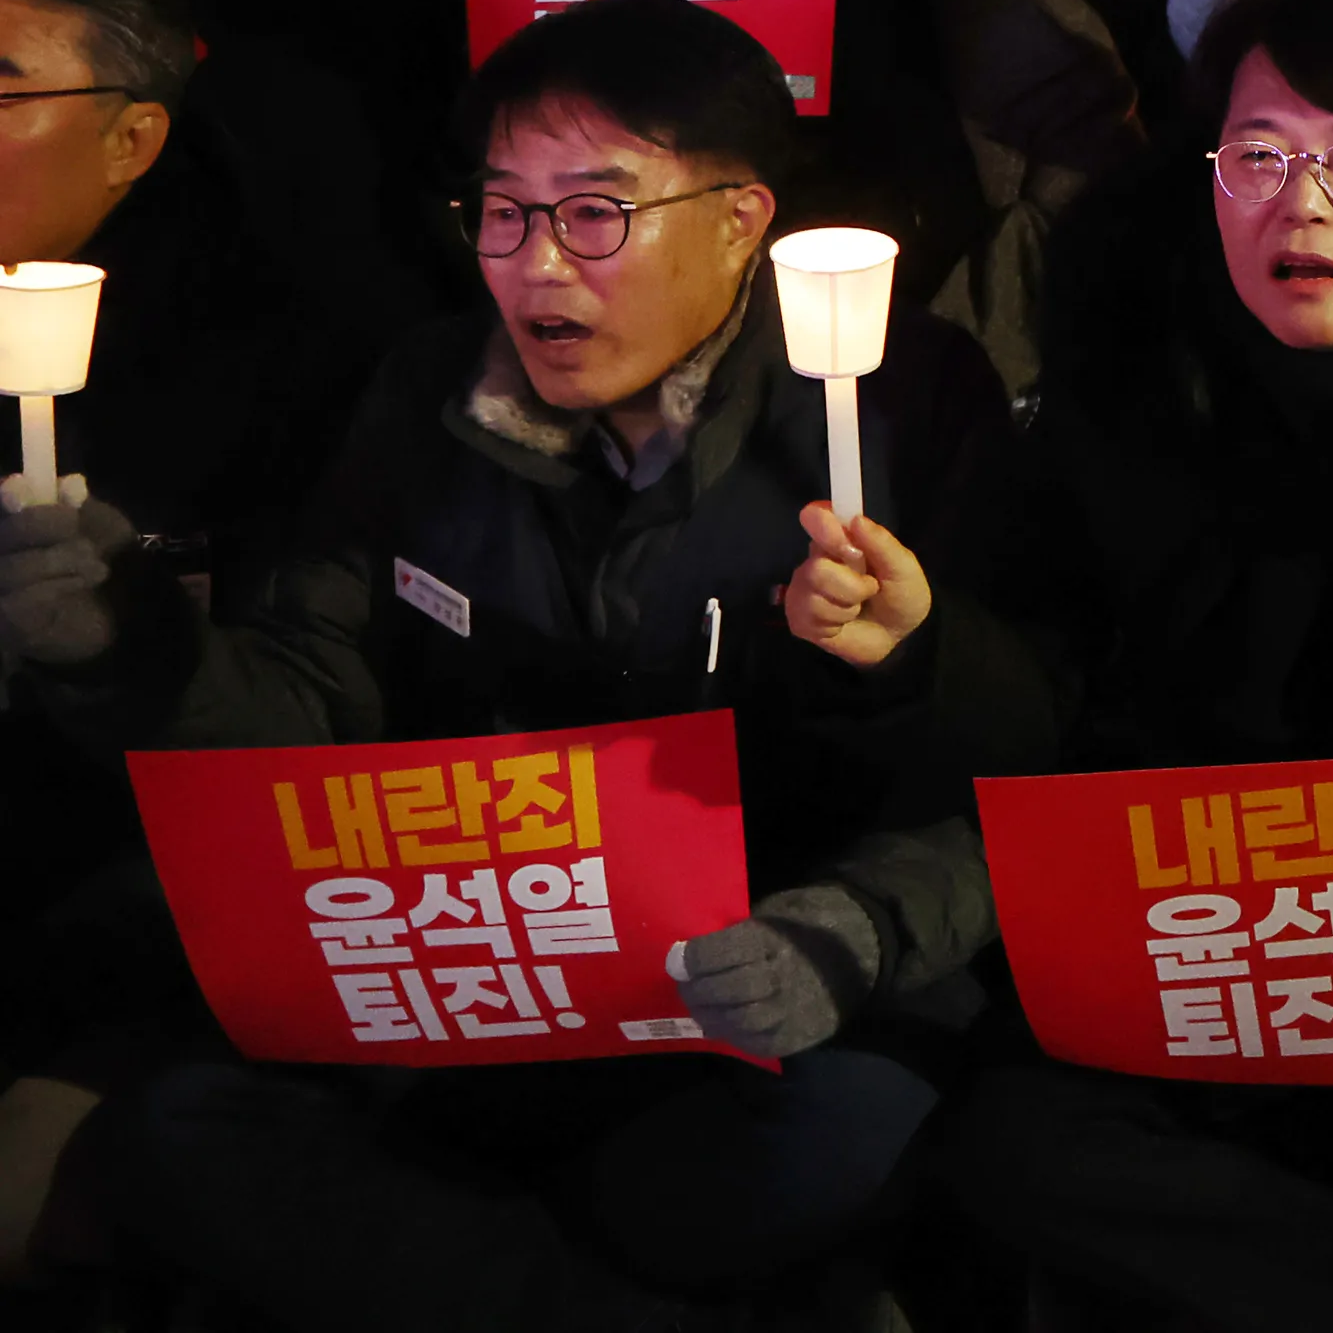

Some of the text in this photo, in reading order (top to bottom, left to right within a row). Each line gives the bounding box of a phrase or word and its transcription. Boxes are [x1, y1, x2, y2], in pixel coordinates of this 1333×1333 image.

[272, 743, 602, 870] 내란죄
[304, 856, 620, 966] 윤석열
[331, 965, 586, 1043] 퇴진!
